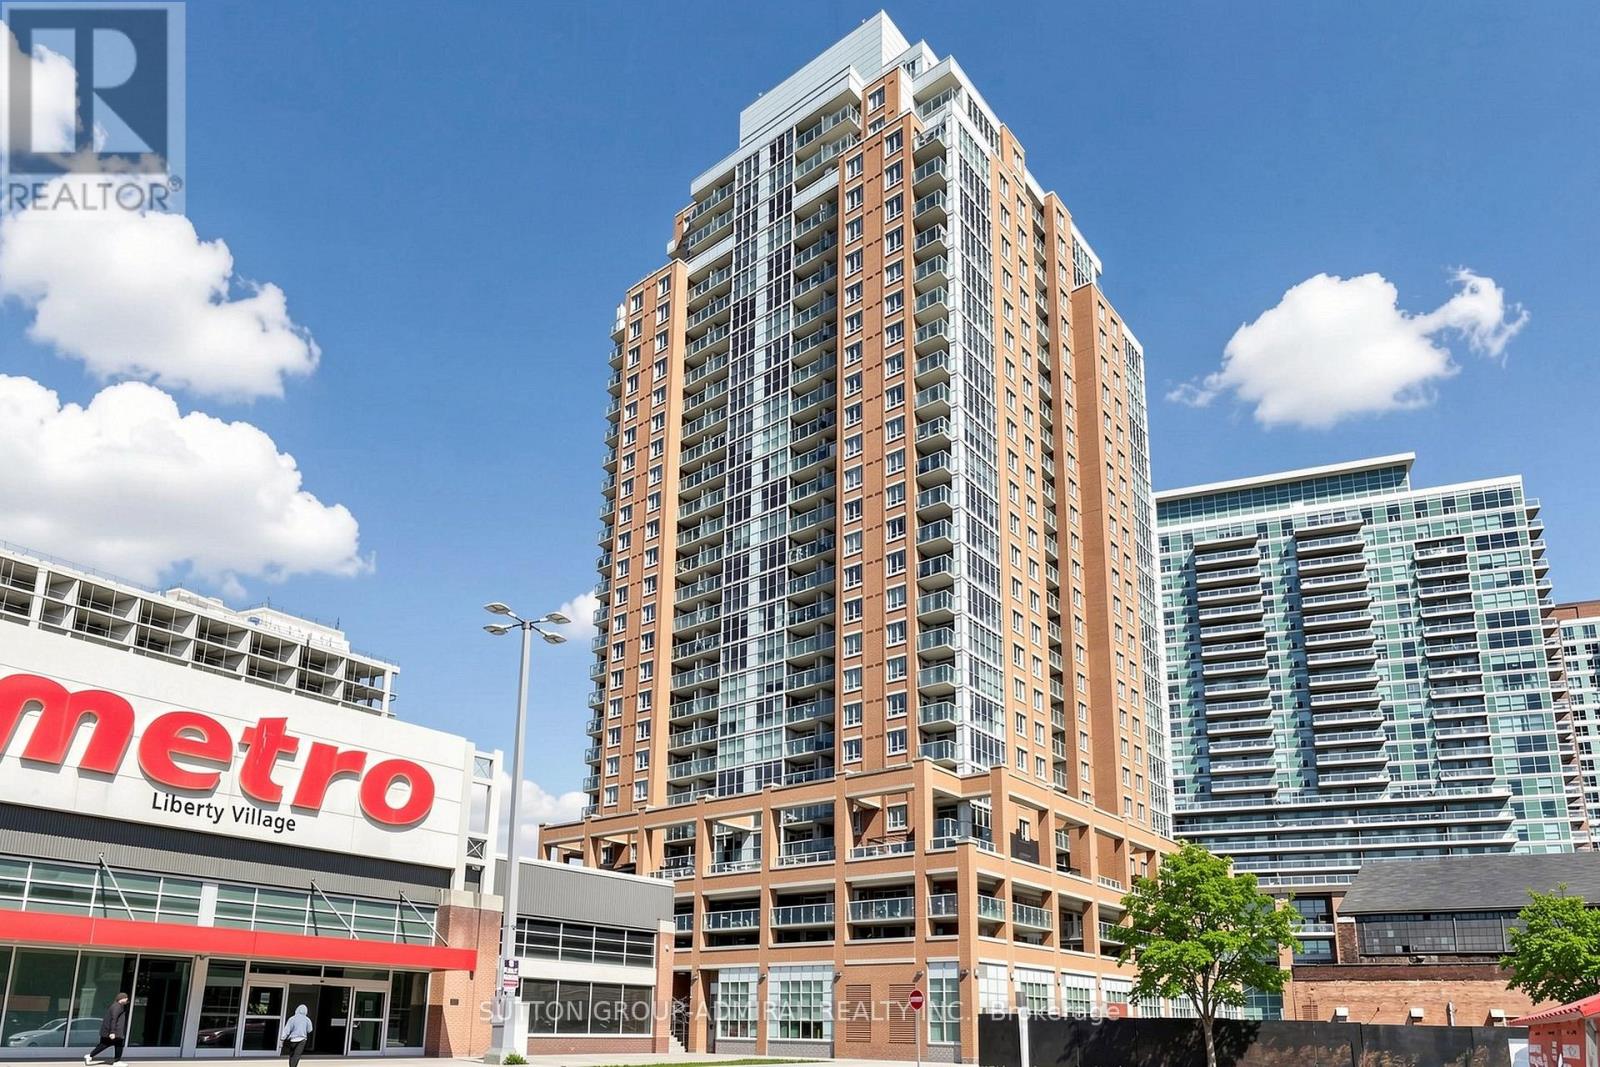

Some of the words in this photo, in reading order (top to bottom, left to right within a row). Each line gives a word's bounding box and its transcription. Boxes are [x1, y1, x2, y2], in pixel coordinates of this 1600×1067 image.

[0, 673, 435, 826] metro
[151, 792, 225, 824] Liberty
[232, 805, 296, 833] Village
